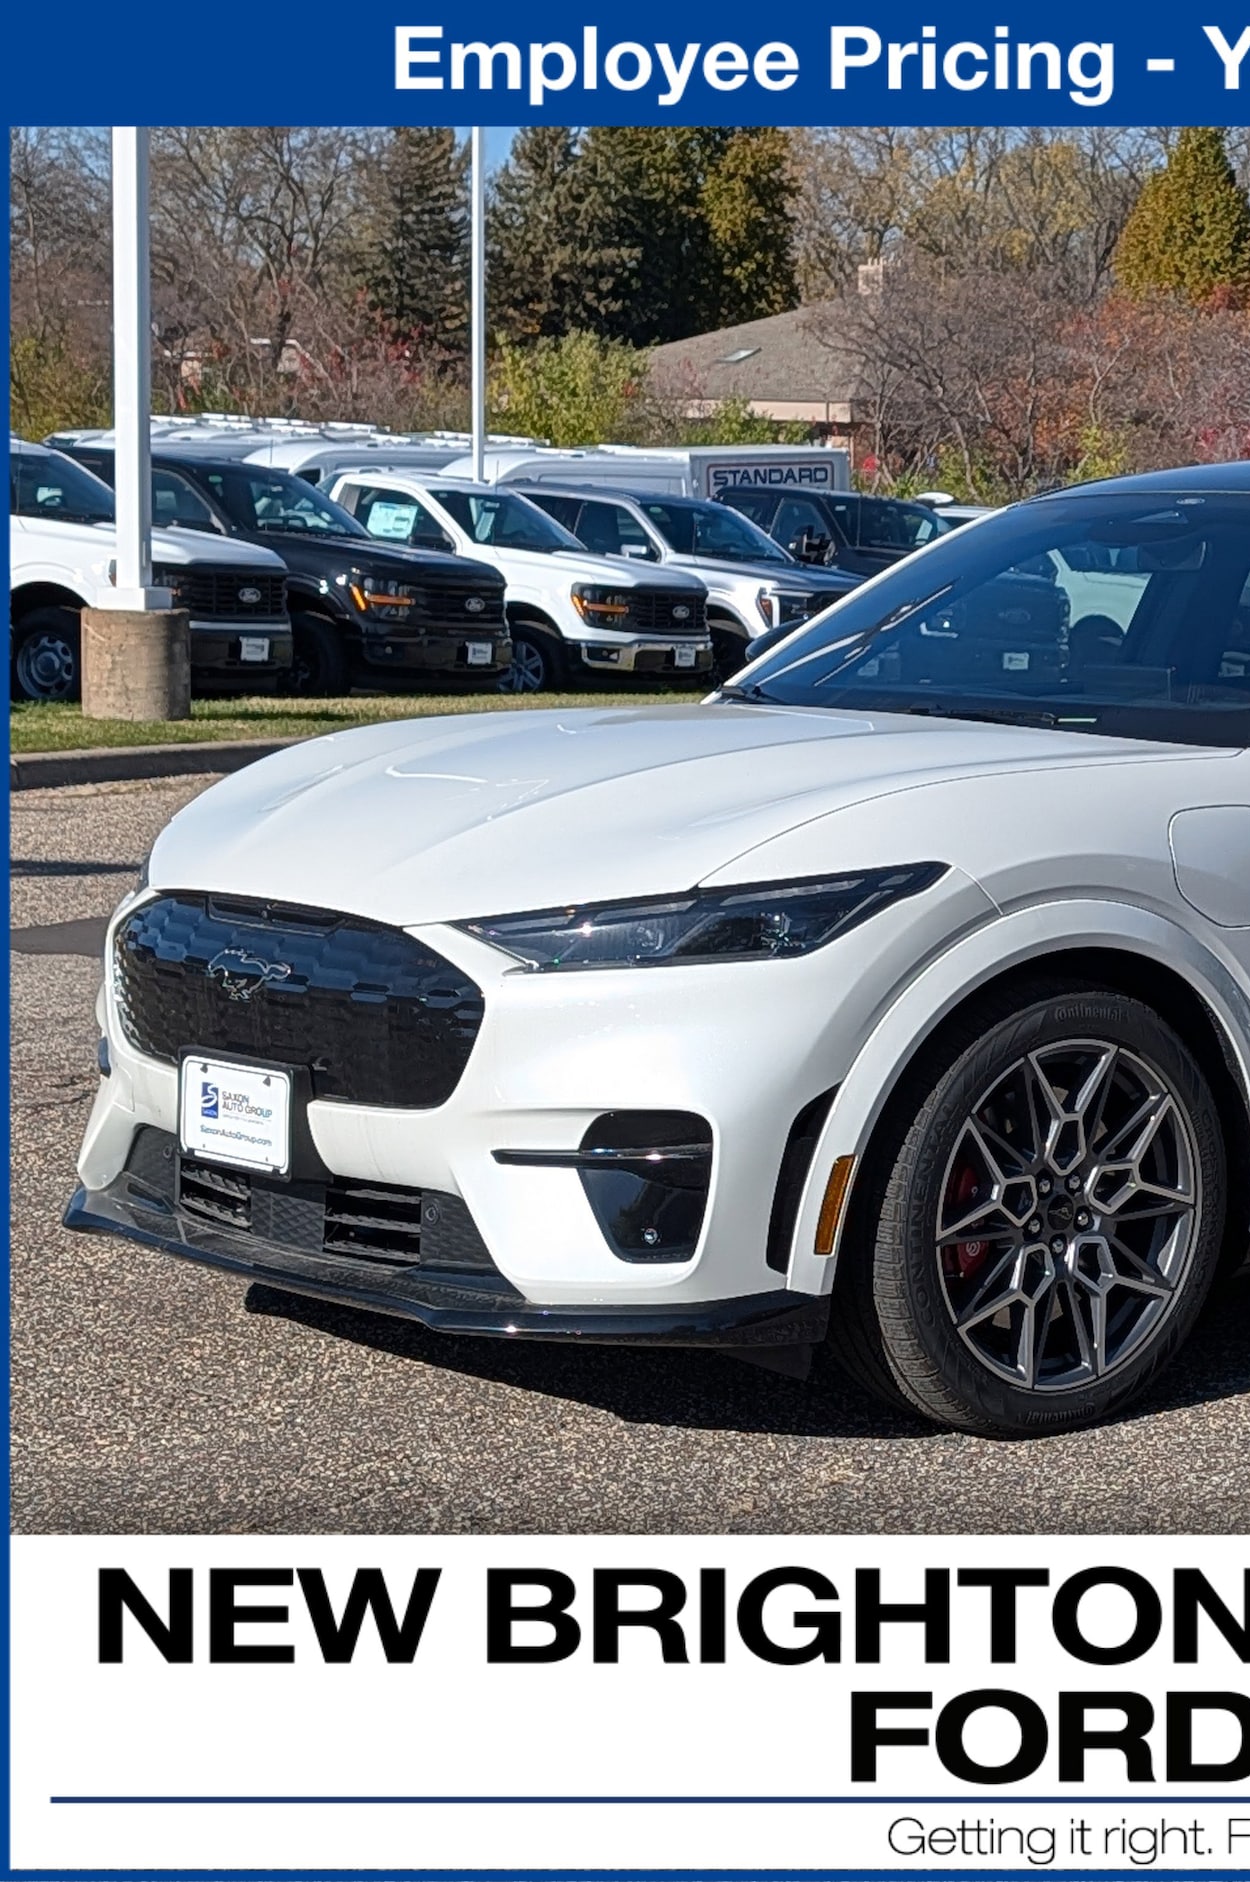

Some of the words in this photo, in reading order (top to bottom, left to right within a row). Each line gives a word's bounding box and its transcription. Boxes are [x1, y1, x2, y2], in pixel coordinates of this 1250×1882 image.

[712, 466, 829, 487] STANDARD
[222, 1091, 249, 1103] SAXON
[222, 1101, 244, 1112] AUTO
[245, 1106, 273, 1118] GROUP
